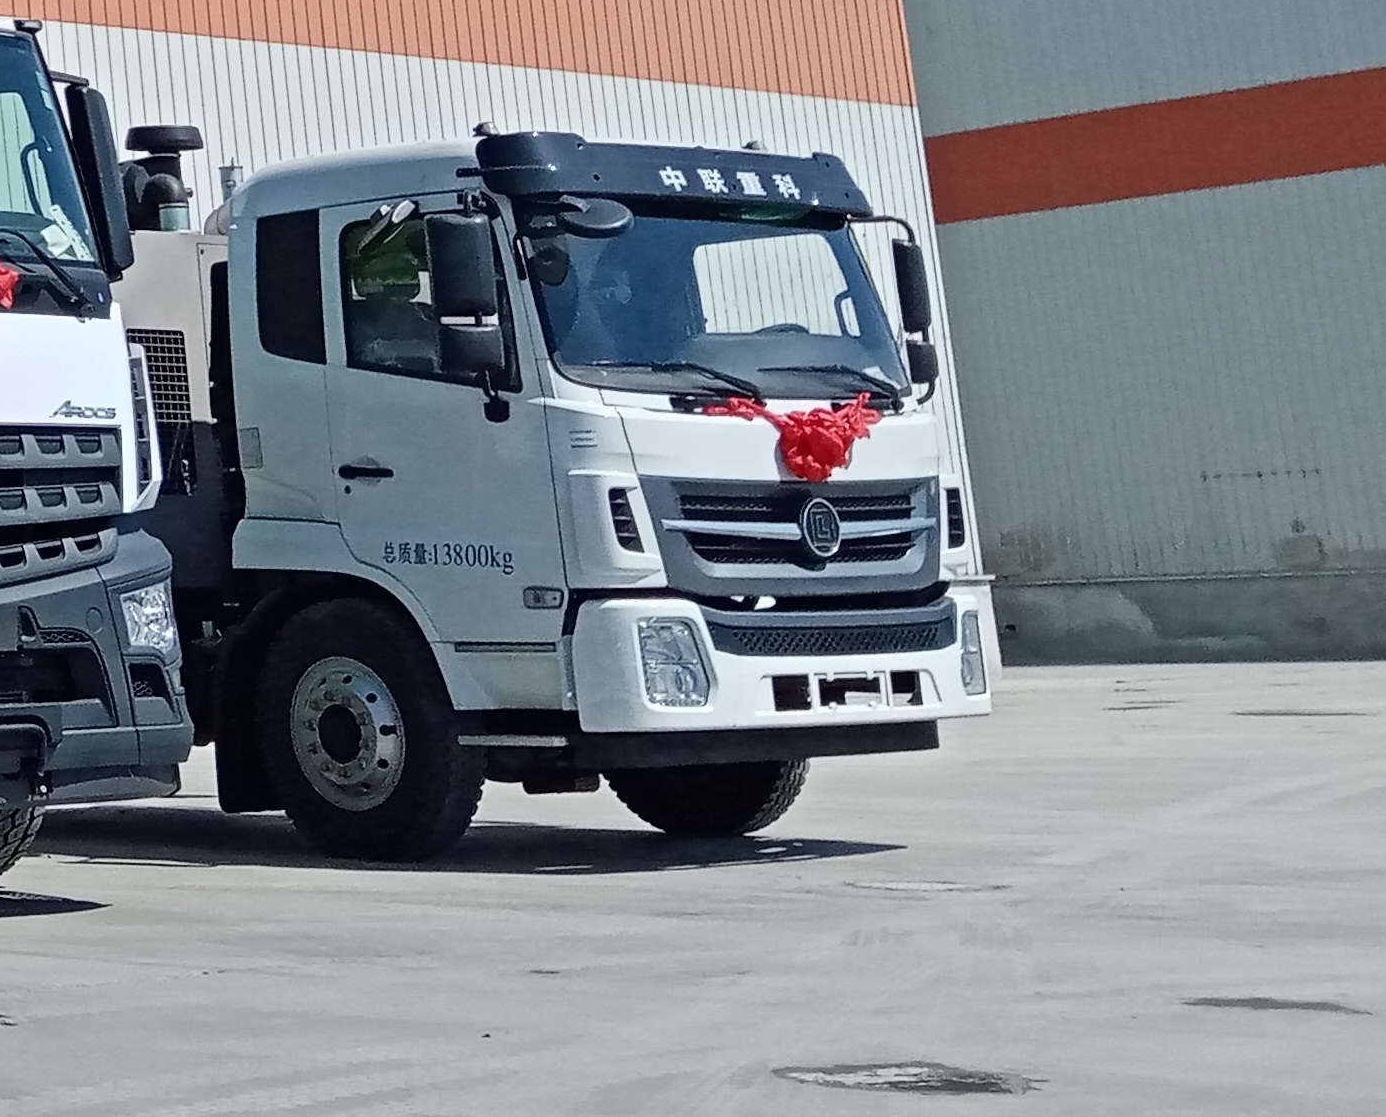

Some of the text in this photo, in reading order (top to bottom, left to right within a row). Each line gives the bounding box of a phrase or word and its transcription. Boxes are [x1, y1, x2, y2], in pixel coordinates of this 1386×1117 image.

[659, 166, 801, 200] 中联重科
[383, 541, 514, 575] 总质量:13800kg
